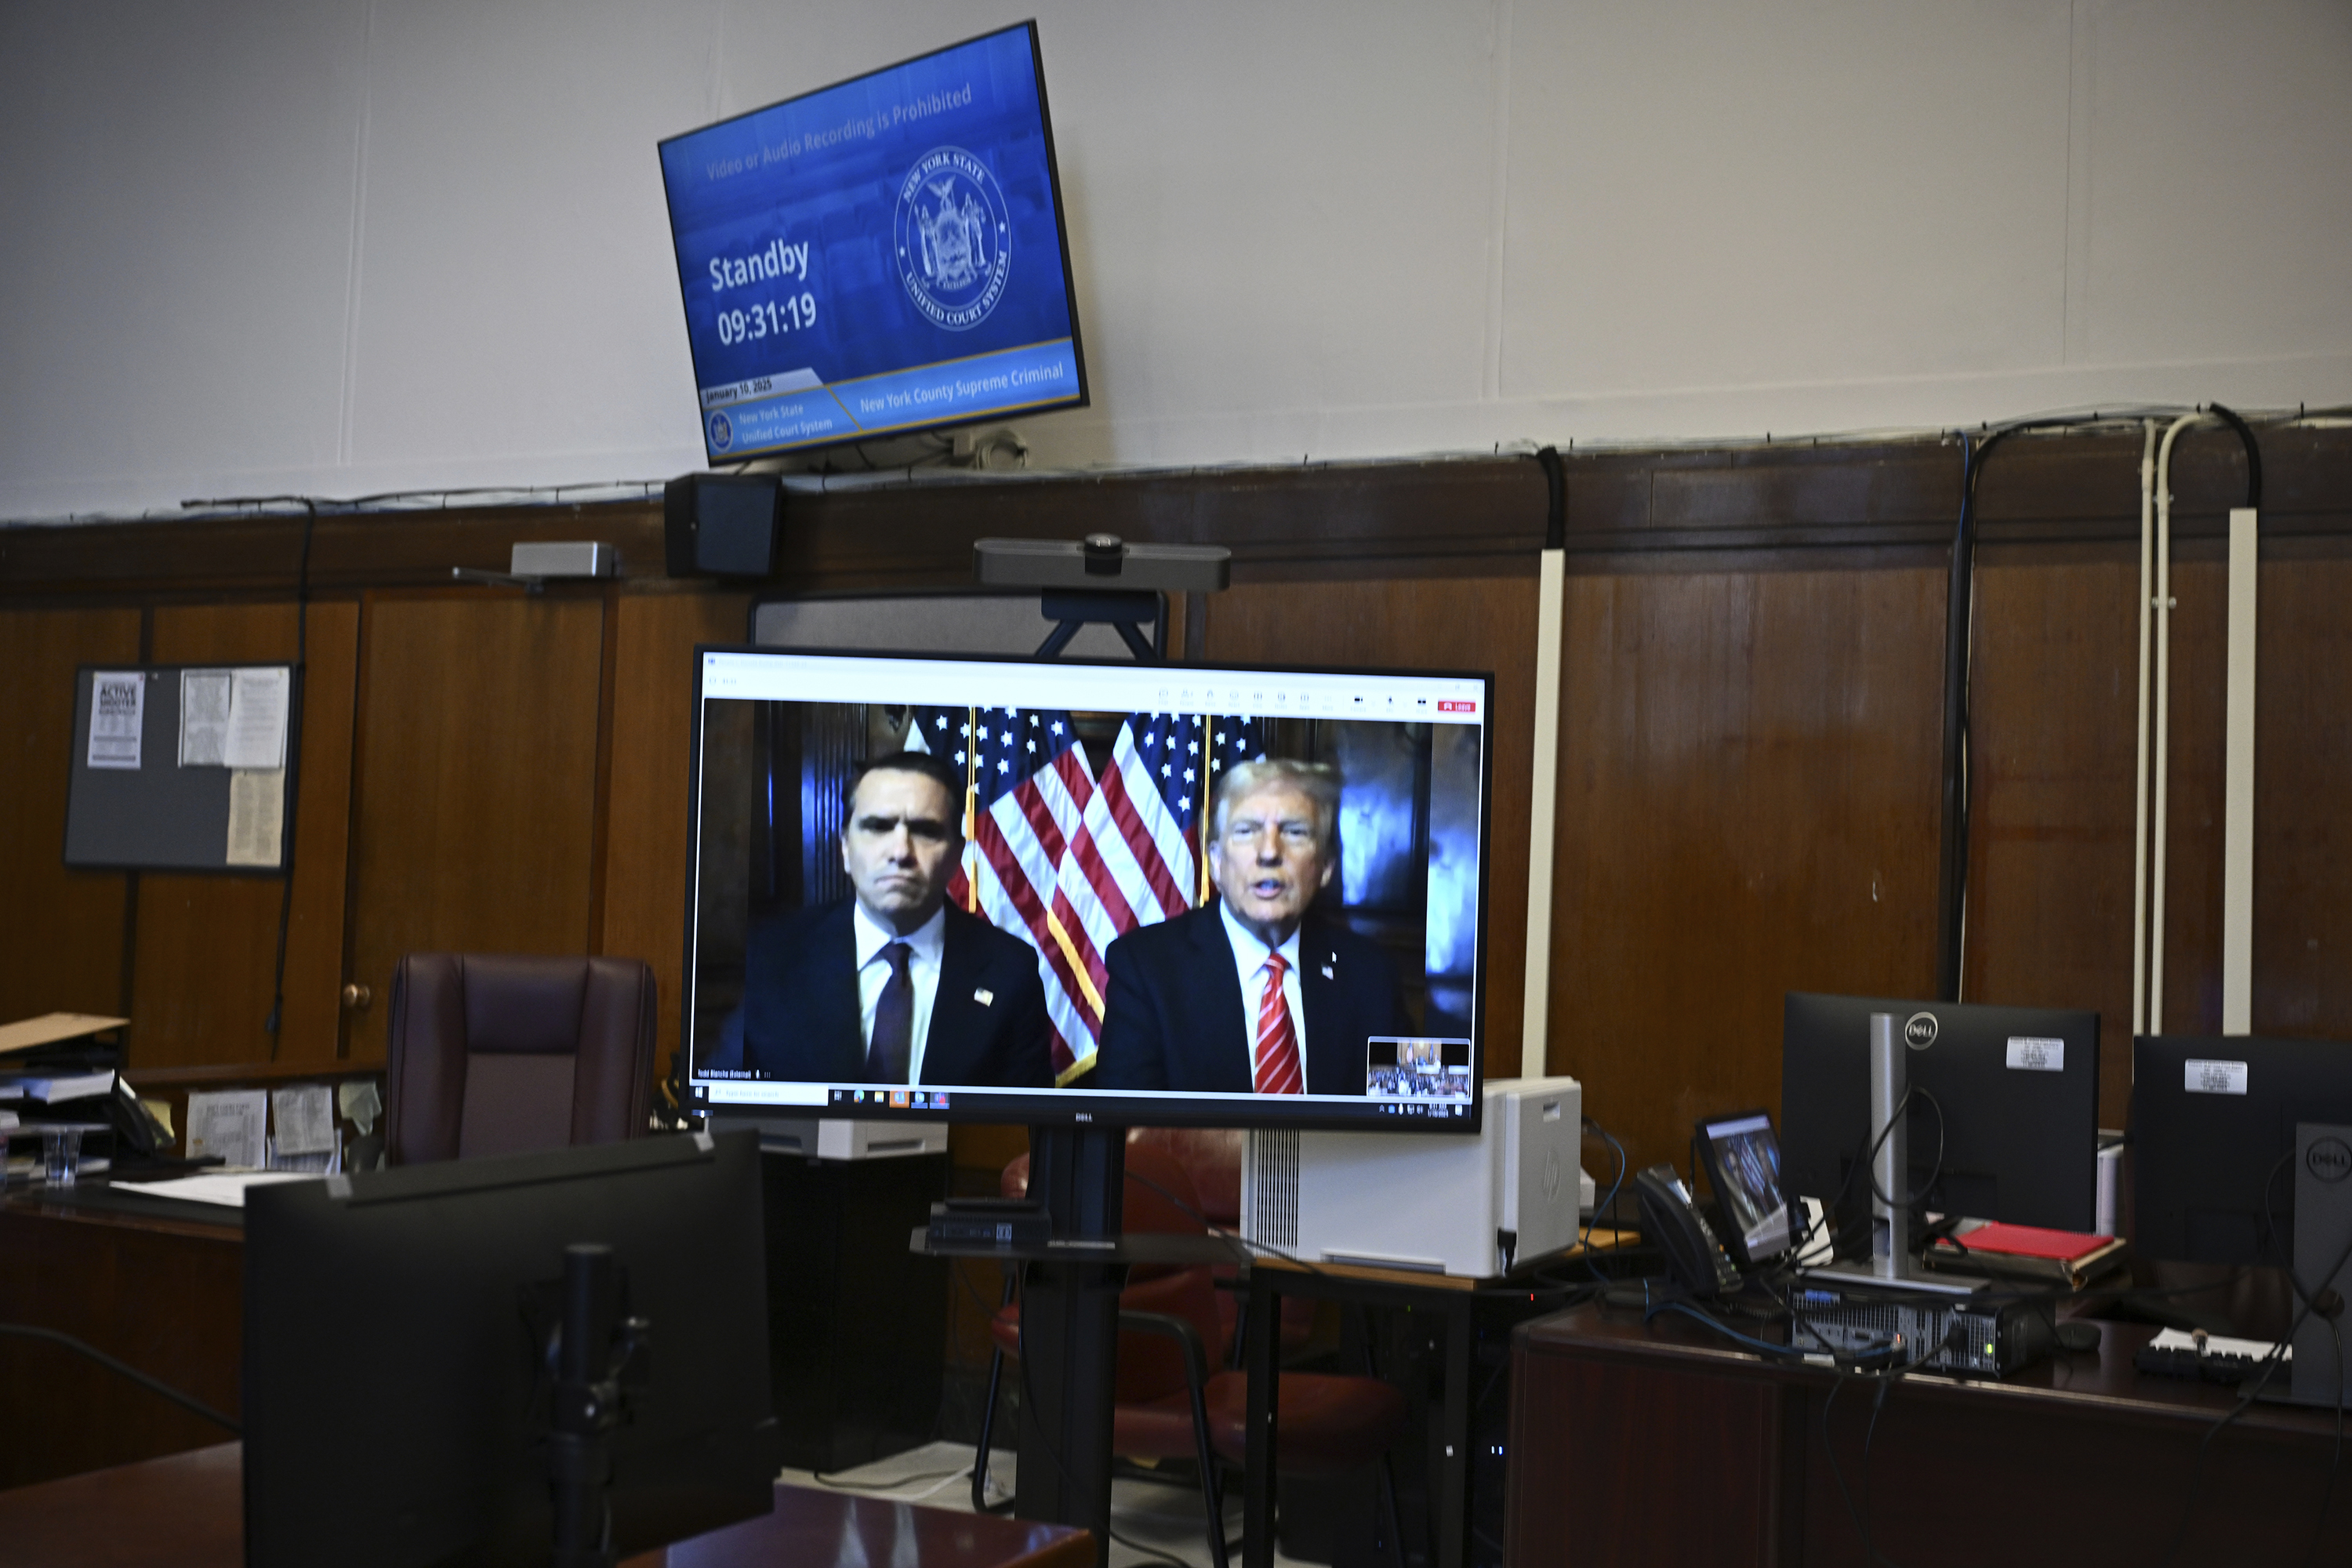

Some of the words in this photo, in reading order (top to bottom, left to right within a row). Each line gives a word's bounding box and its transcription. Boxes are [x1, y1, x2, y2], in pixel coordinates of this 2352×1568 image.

[706, 159, 742, 181] Video
[746, 153, 759, 169] or
[763, 139, 801, 165] Audio
[805, 118, 876, 152] Recording
[892, 82, 972, 125] Prohibited
[903, 167, 921, 204] NEW
[921, 151, 950, 174] YORK
[953, 153, 985, 184] STATE
[709, 238, 808, 292] Standby
[906, 271, 944, 322] UNIFIED
[946, 302, 982, 326] COURT
[982, 249, 1007, 310] SYSTEM
[717, 292, 817, 347] 09:31:19
[706, 387, 738, 405] January
[739, 383, 752, 394] 10,
[753, 377, 772, 392] 2025
[861, 398, 884, 413] New
[886, 393, 912, 408] York
[914, 384, 954, 404] County
[956, 375, 1008, 398] Supreme
[1011, 361, 1063, 387] Criminal
[739, 412, 758, 425] New
[759, 406, 779, 421] York
[780, 404, 804, 418] State
[742, 428, 773, 445] Unified
[774, 423, 799, 438] Court
[800, 419, 833, 437] System
[1908, 1023, 1934, 1037] DELL
[1075, 1112, 1093, 1122] DELL
